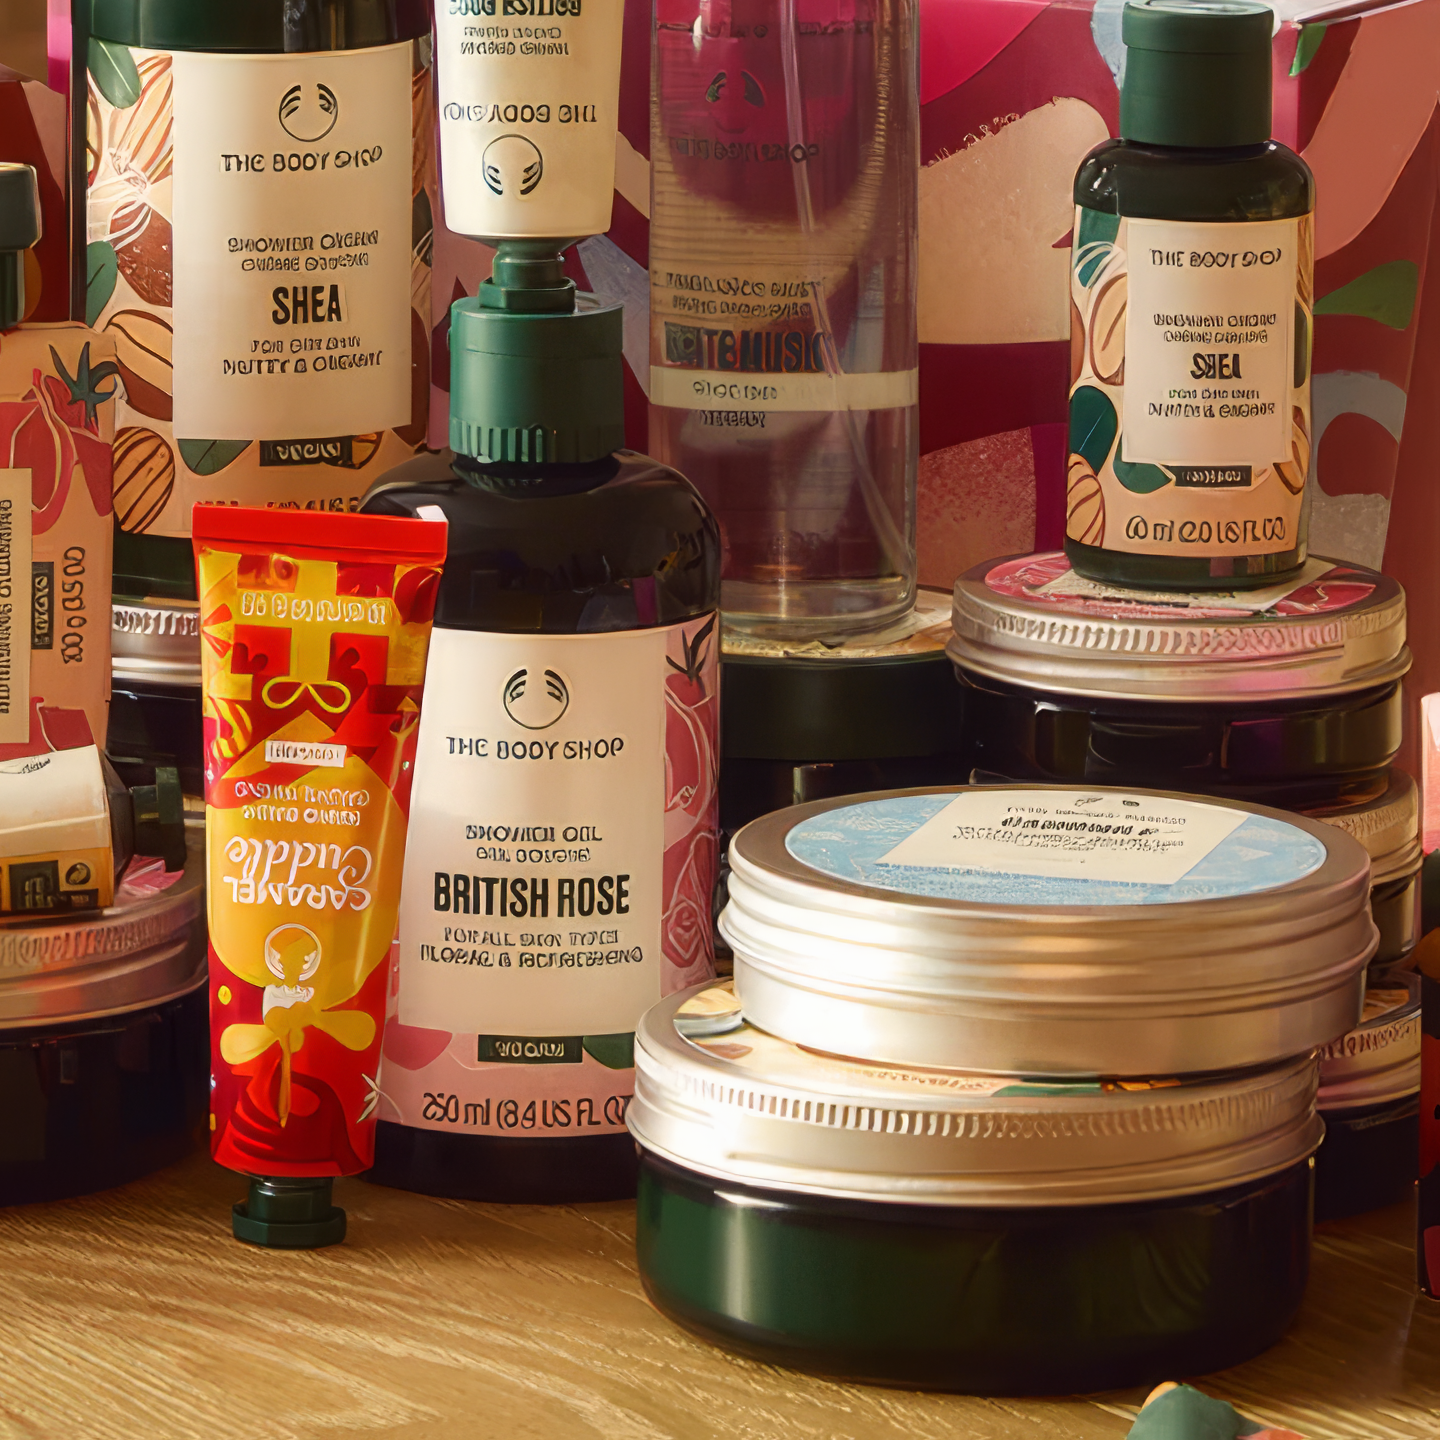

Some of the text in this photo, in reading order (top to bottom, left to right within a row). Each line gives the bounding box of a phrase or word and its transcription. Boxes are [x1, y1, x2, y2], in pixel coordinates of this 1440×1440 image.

[221, 154, 265, 172] THE
[272, 284, 342, 324] SHEA
[446, 736, 625, 761] THE BODY SHOP
[225, 835, 374, 888] Cuddle
[433, 871, 631, 918] BRITISH ROSE
[422, 1092, 460, 1124] 250
[463, 1096, 491, 1126] ml
[541, 1098, 571, 1129] US
[577, 1097, 601, 1125] FL
